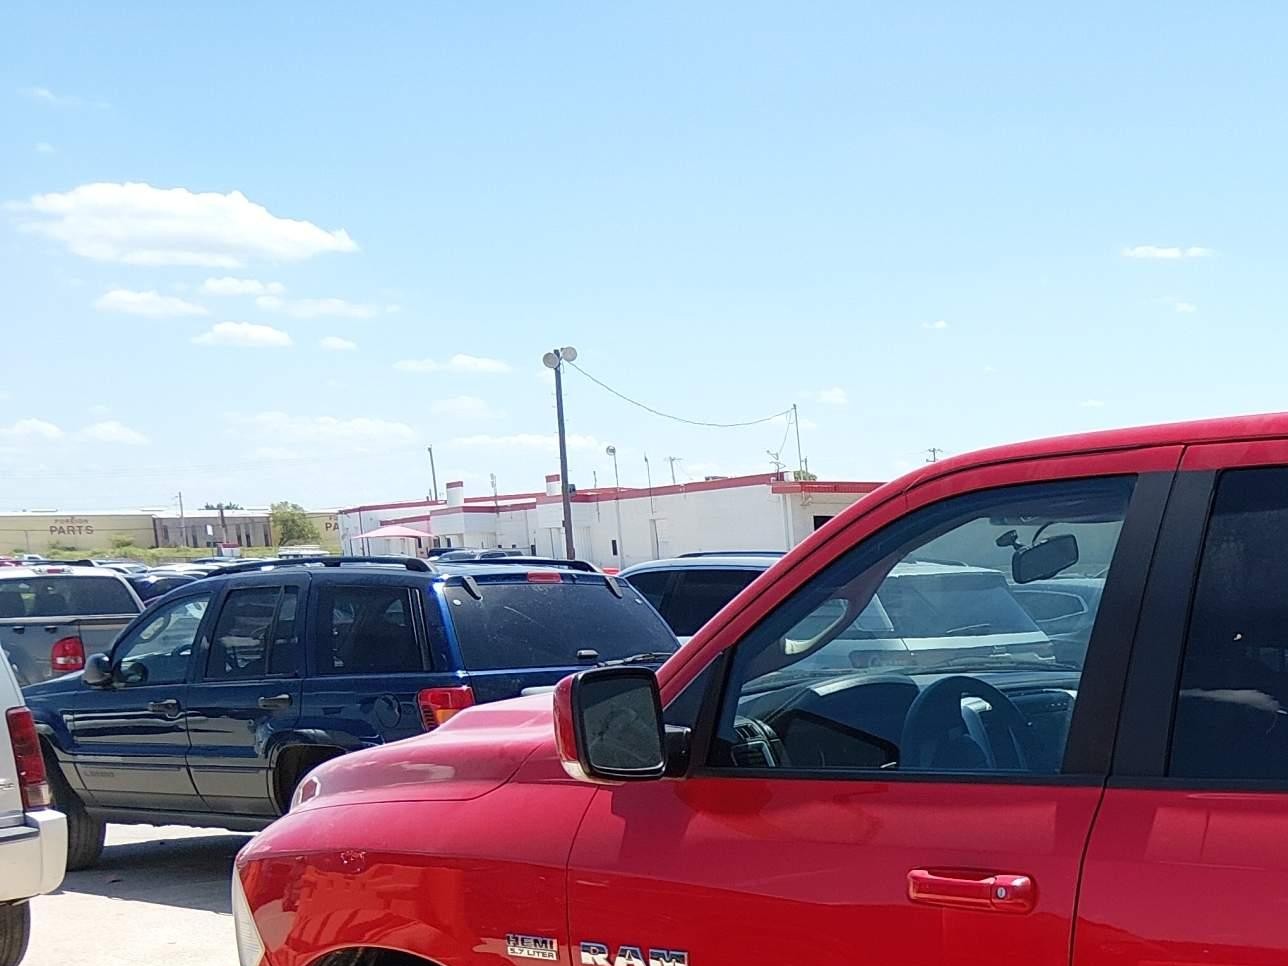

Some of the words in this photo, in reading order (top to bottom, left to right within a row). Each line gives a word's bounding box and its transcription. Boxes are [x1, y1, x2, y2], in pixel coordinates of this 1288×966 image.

[49, 525, 94, 535] PARTS
[506, 935, 554, 950] HEMI
[527, 950, 554, 958] LITER
